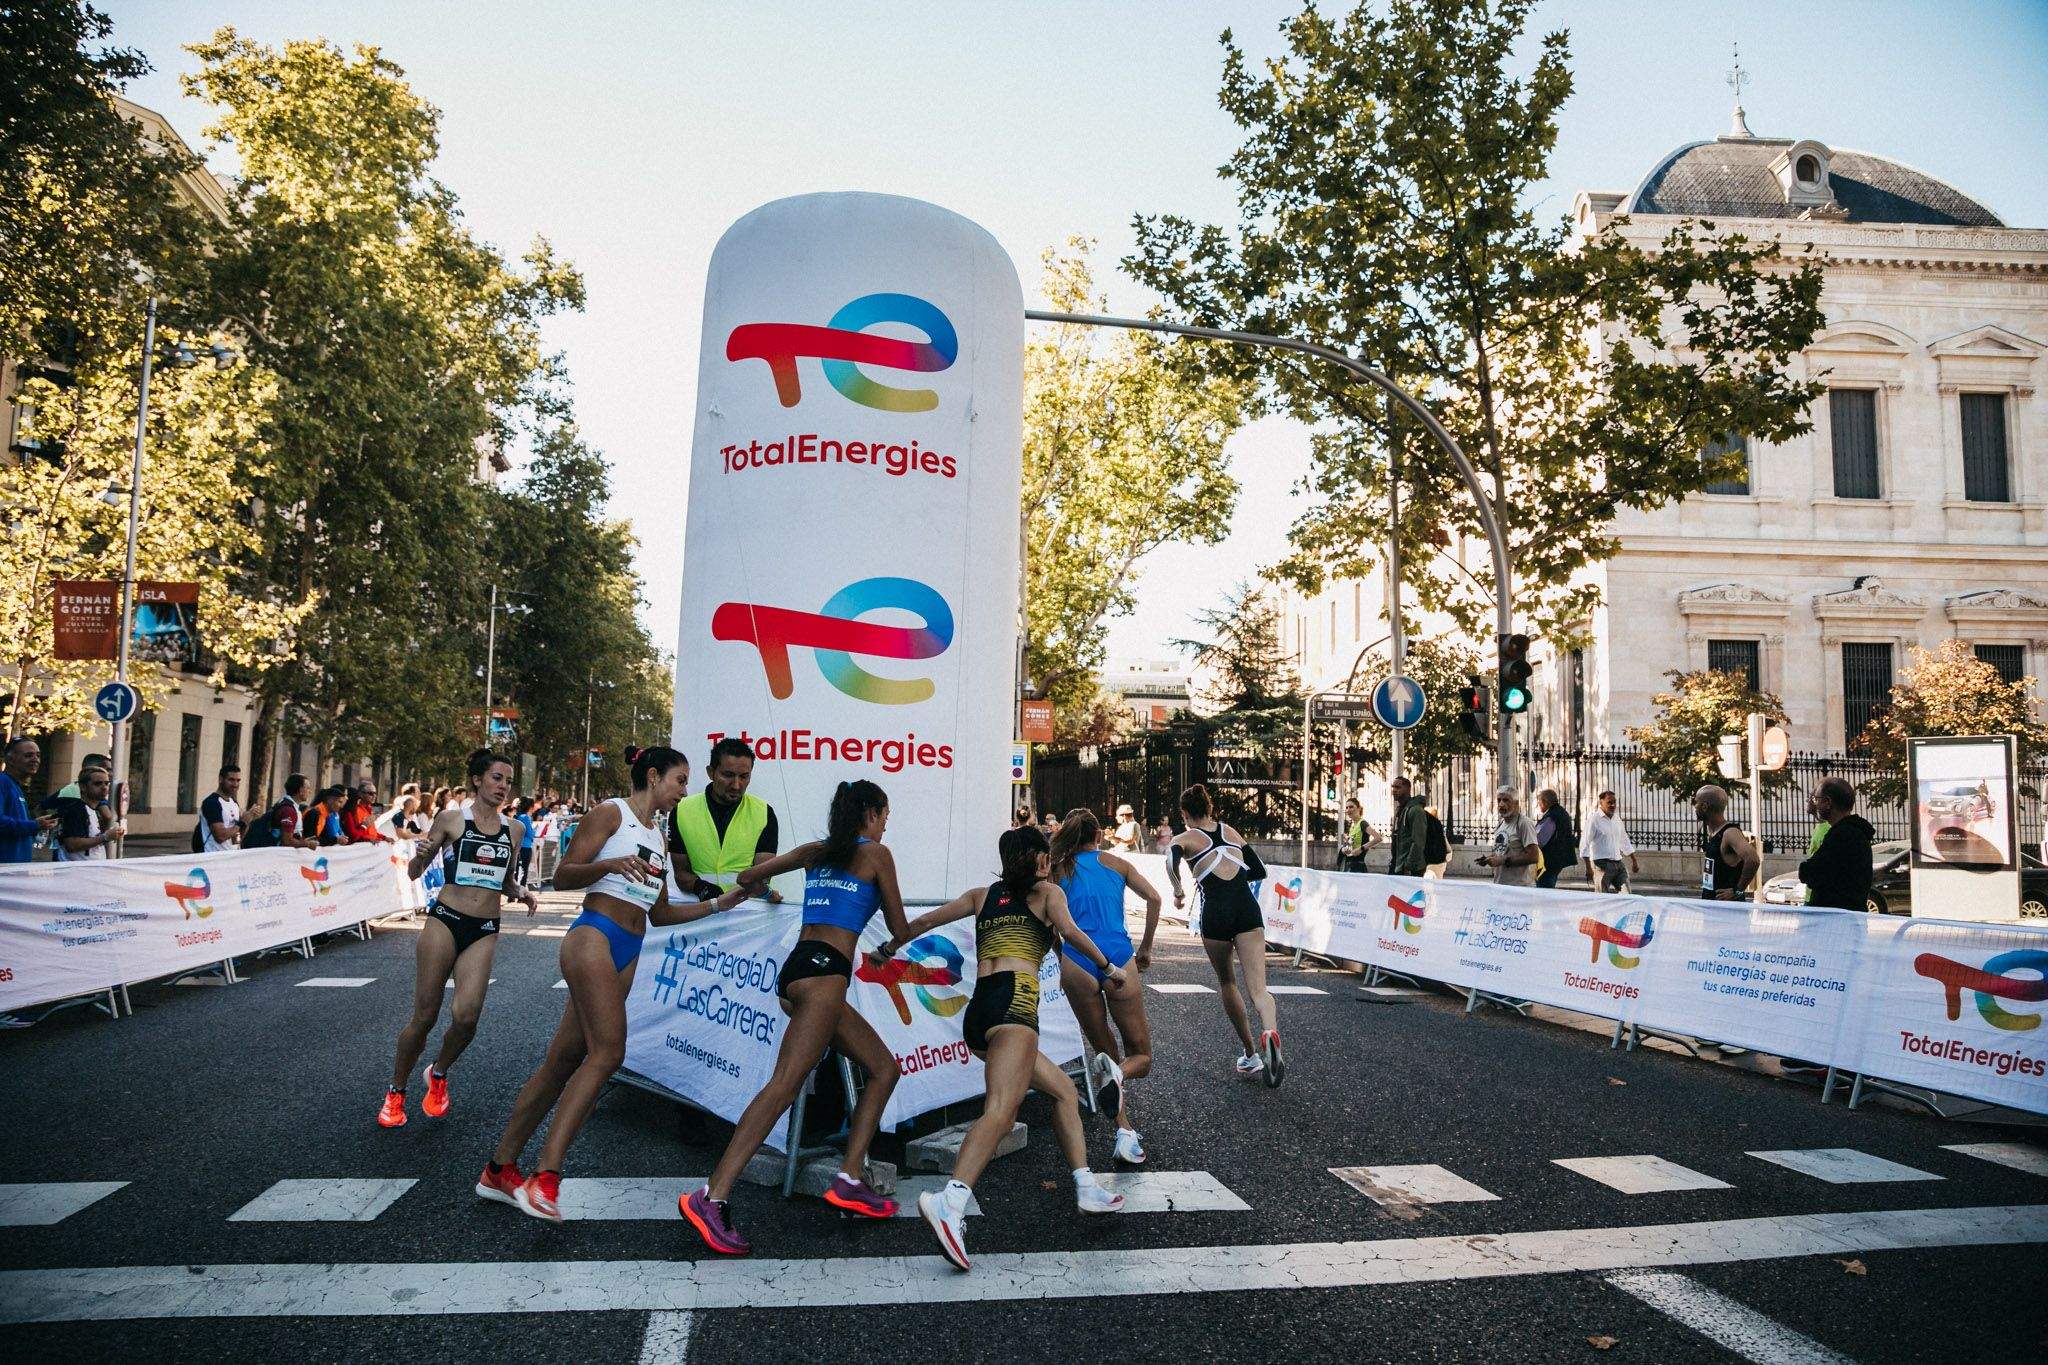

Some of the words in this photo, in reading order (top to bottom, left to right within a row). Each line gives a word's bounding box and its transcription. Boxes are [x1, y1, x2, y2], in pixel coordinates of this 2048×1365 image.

[720, 434, 957, 478] TotalEnergies
[61, 594, 111, 604] FERNÁN
[141, 590, 167, 600] ISLA
[61, 605, 111, 614] GÓMEZ
[1332, 709, 1351, 717] ARMADA
[707, 729, 954, 773] TtalEnergies
[1207, 760, 1248, 774] MAN
[1228, 778, 1270, 786] ARQUEOLÓGICO
[496, 846, 509, 858] 23
[174, 928, 223, 948] TotalEnergies
[1377, 937, 1420, 957] TotalEnergies
[1459, 958, 1502, 973] totalenergies.es
[1718, 946, 1750, 960] Somos
[1753, 950, 1761, 962] la
[1764, 953, 1816, 968] compañía
[1687, 958, 1766, 981] multienergías
[1769, 972, 1789, 984] que
[1791, 974, 1846, 992] patrocina
[1564, 972, 1639, 999] TotalEnergies
[1703, 980, 1718, 992] tus
[1720, 983, 1760, 998] carreras
[1761, 989, 1816, 1008] preferidas
[665, 1032, 741, 1079] totalenergies.es
[1901, 1031, 2046, 1076] TotalEnergies
